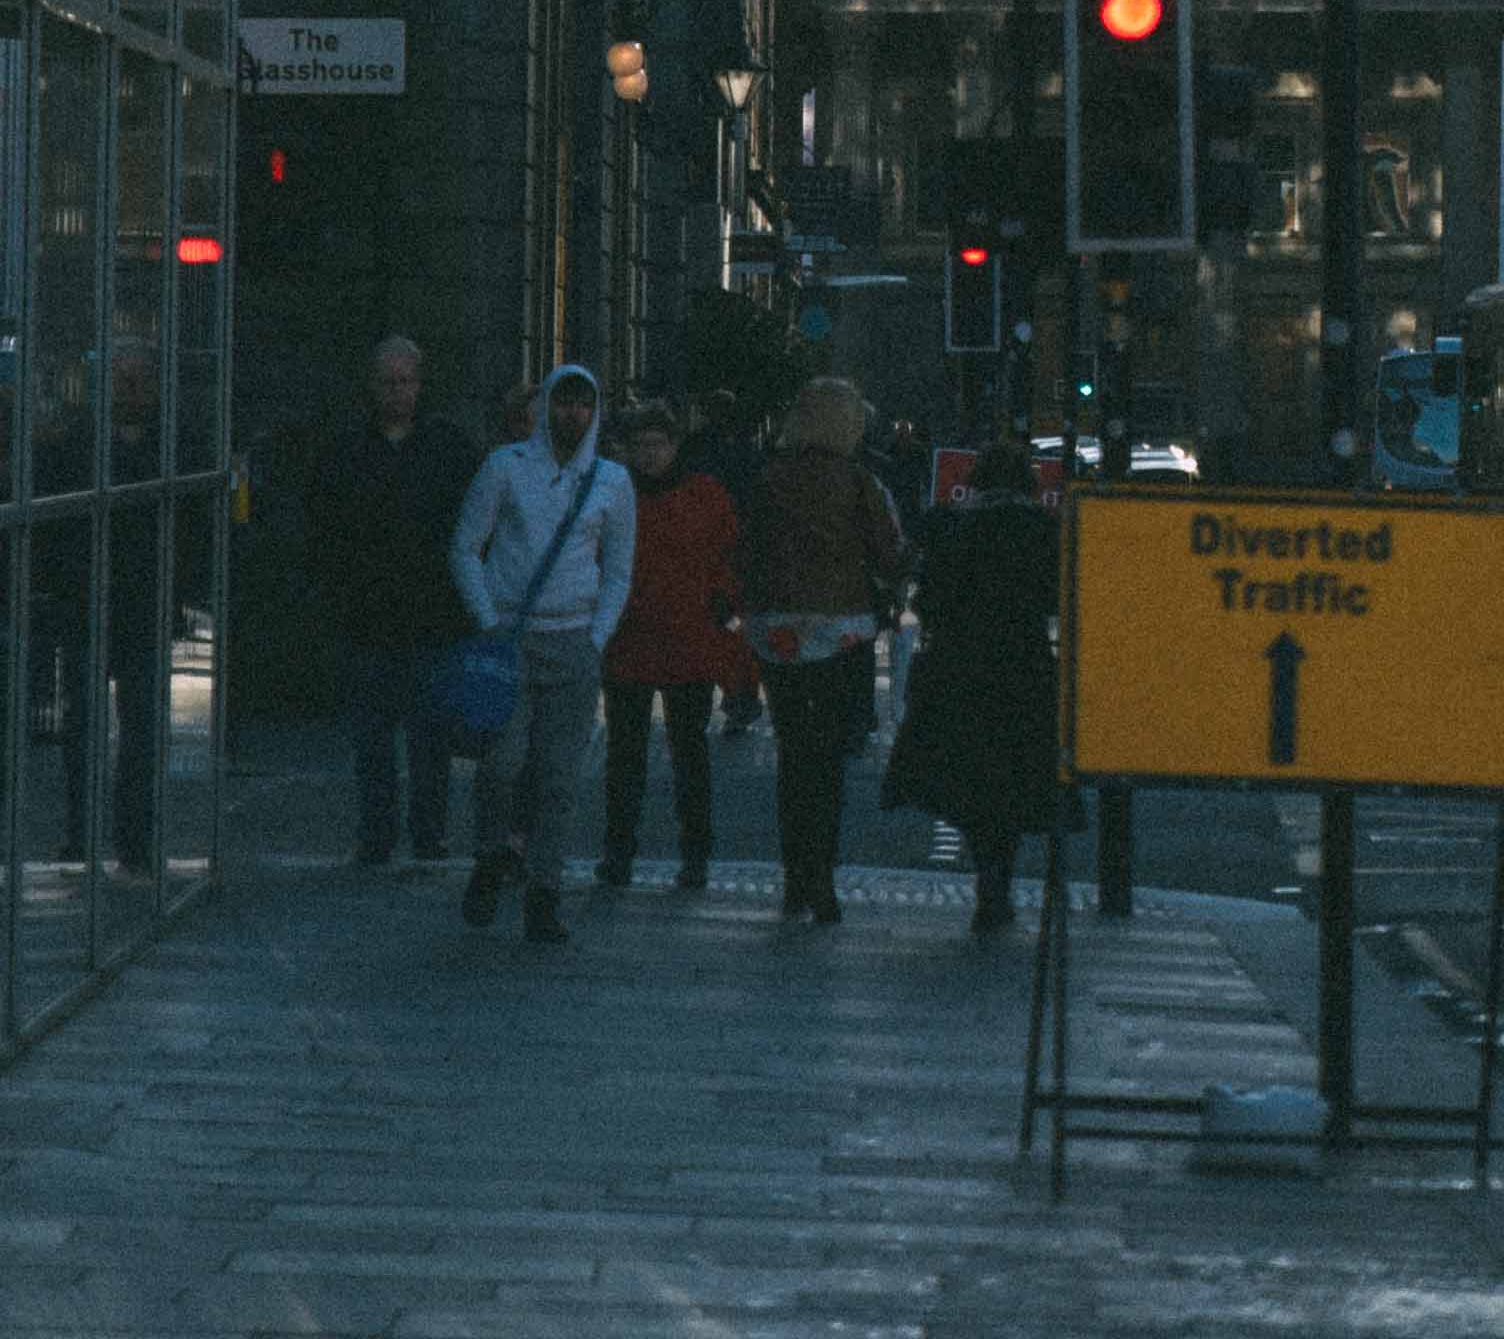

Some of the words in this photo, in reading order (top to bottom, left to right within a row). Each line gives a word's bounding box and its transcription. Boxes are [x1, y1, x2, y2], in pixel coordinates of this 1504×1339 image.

[287, 27, 338, 52] The
[1192, 514, 1392, 562] Diverted
[1214, 568, 1370, 615] Traffic
